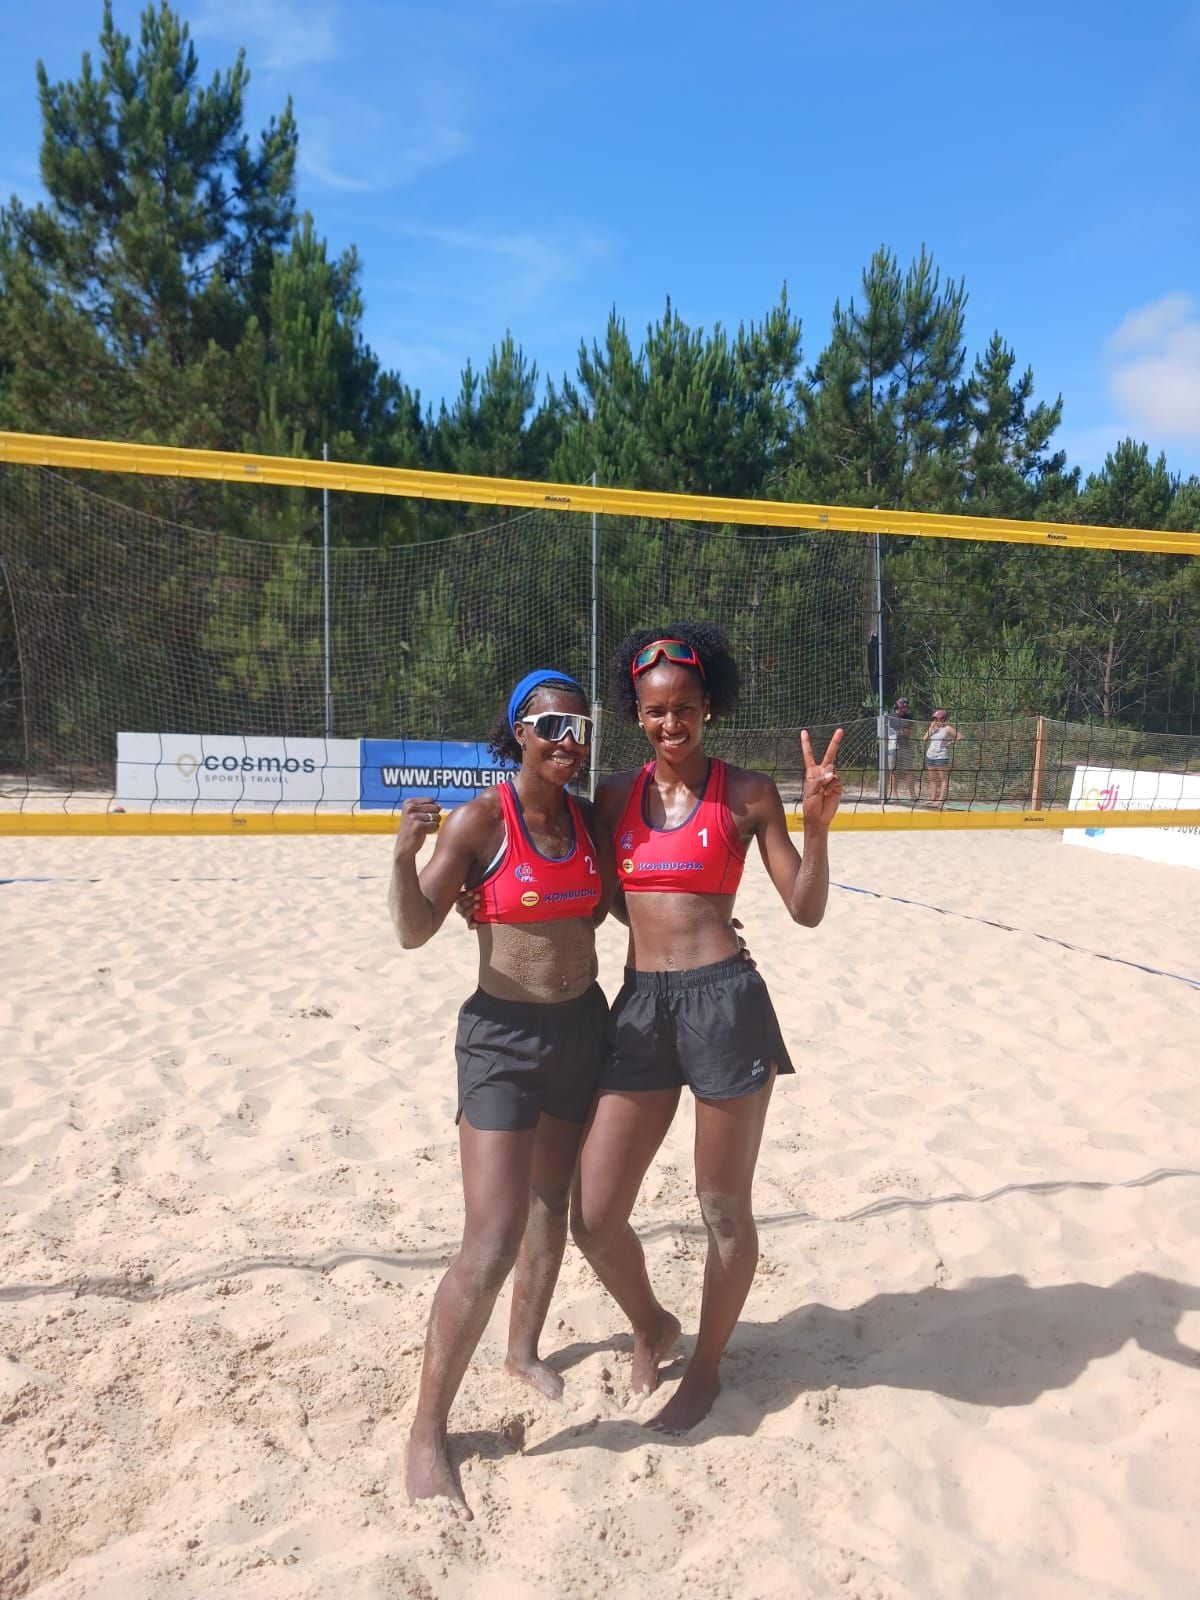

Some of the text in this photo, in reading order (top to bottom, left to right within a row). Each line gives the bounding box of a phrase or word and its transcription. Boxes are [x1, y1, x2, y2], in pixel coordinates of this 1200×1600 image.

[204, 755, 316, 774] cosmos
[205, 775, 247, 783] SPORTS
[382, 767, 520, 787] WWW.FPVOLEIBO
[697, 828, 708, 849] 1
[584, 856, 597, 875] 2
[638, 861, 705, 872] KOMBUCHA
